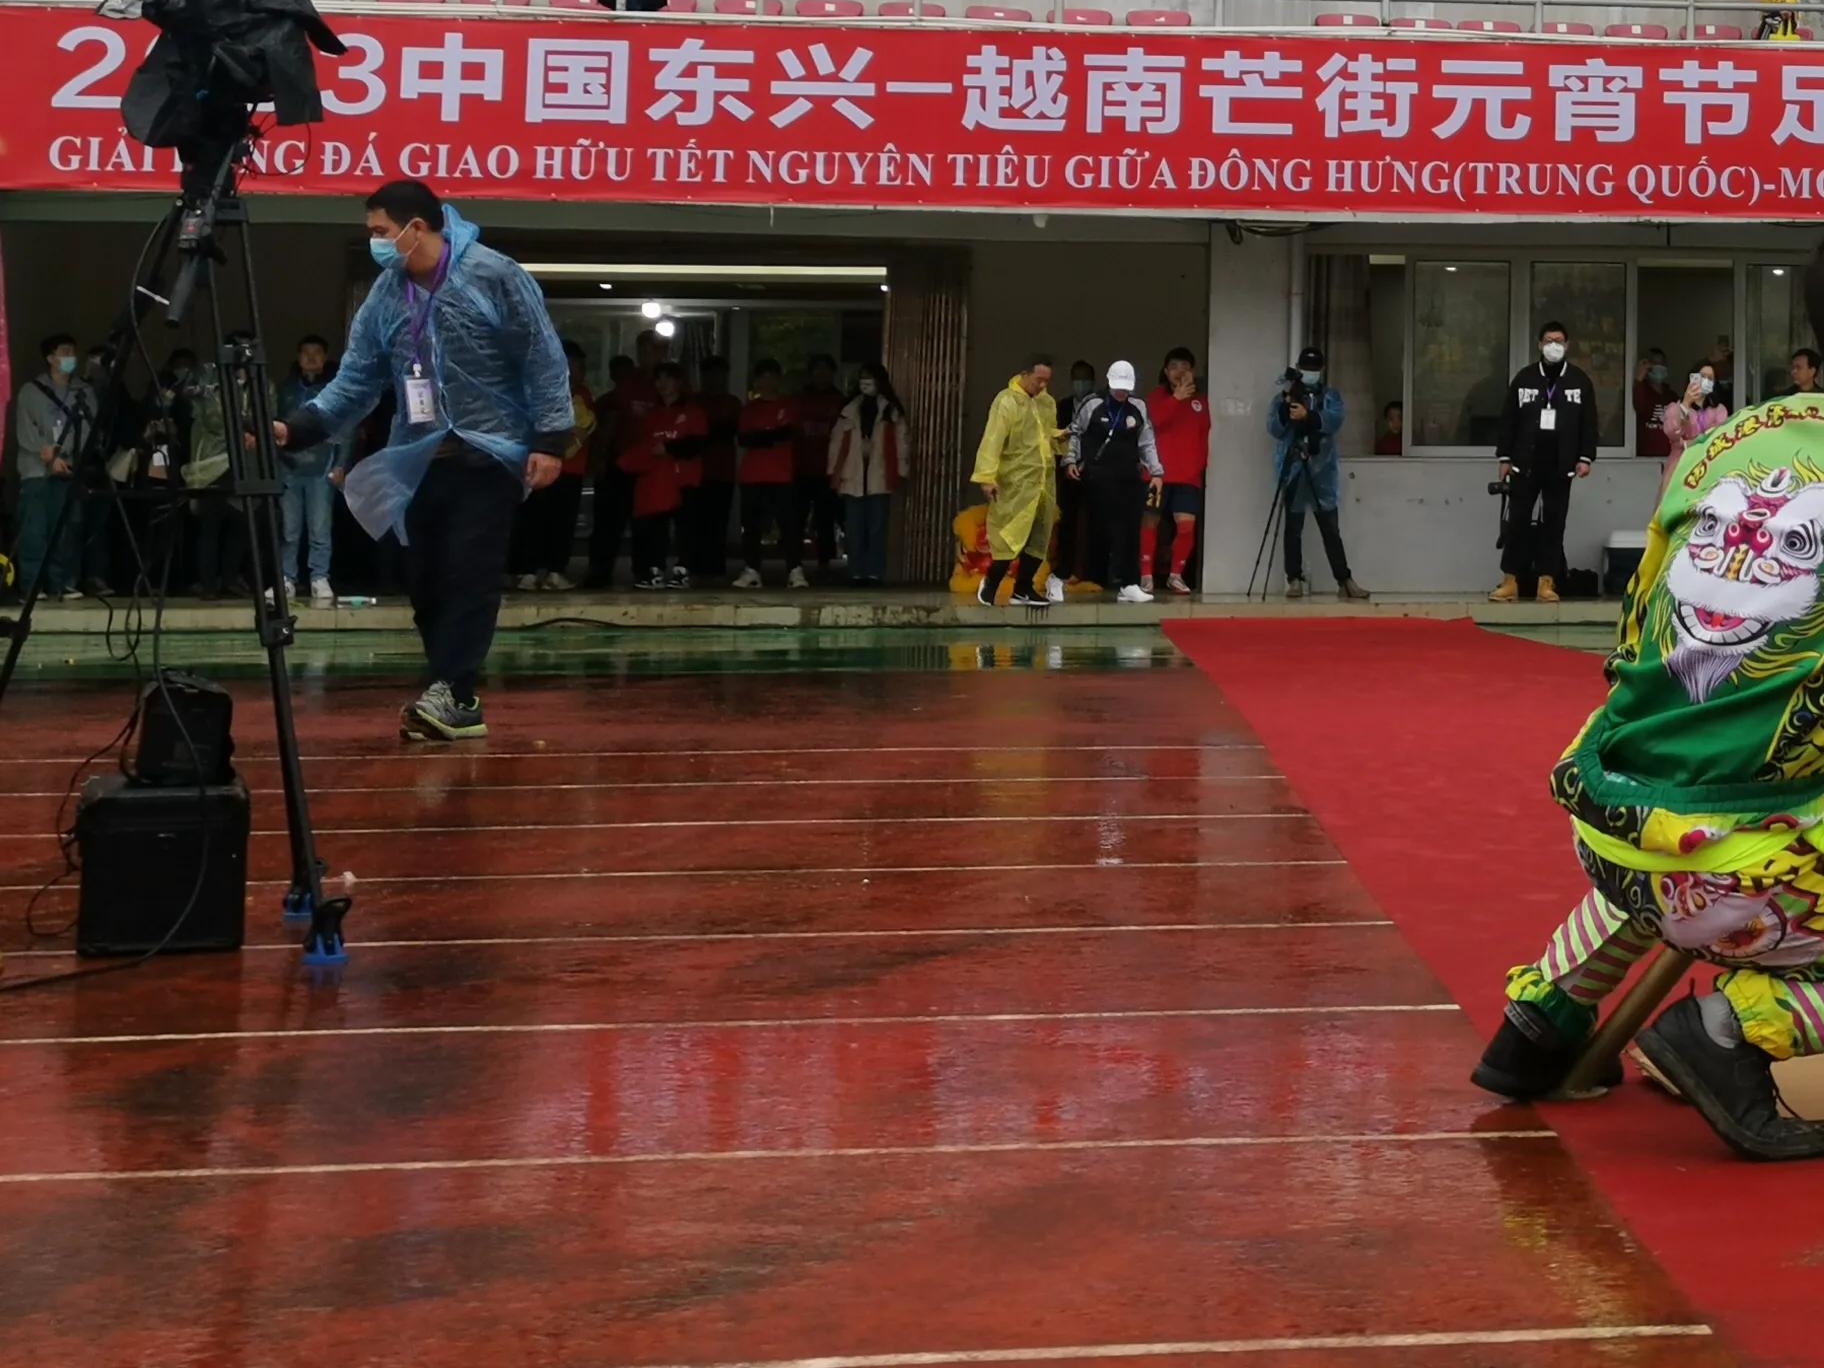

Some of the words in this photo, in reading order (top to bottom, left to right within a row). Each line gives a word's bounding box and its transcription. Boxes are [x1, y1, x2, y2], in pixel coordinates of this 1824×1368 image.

[320, 132, 384, 177] ĐÁ
[399, 142, 519, 180] GIAO
[533, 137, 635, 181] HỮU
[647, 139, 734, 183] TẾT
[746, 142, 934, 186] NGUYÊN
[947, 144, 1053, 188] TIÊU
[1065, 148, 1178, 191] GIỮA
[1187, 148, 1313, 193] ĐÔNG
